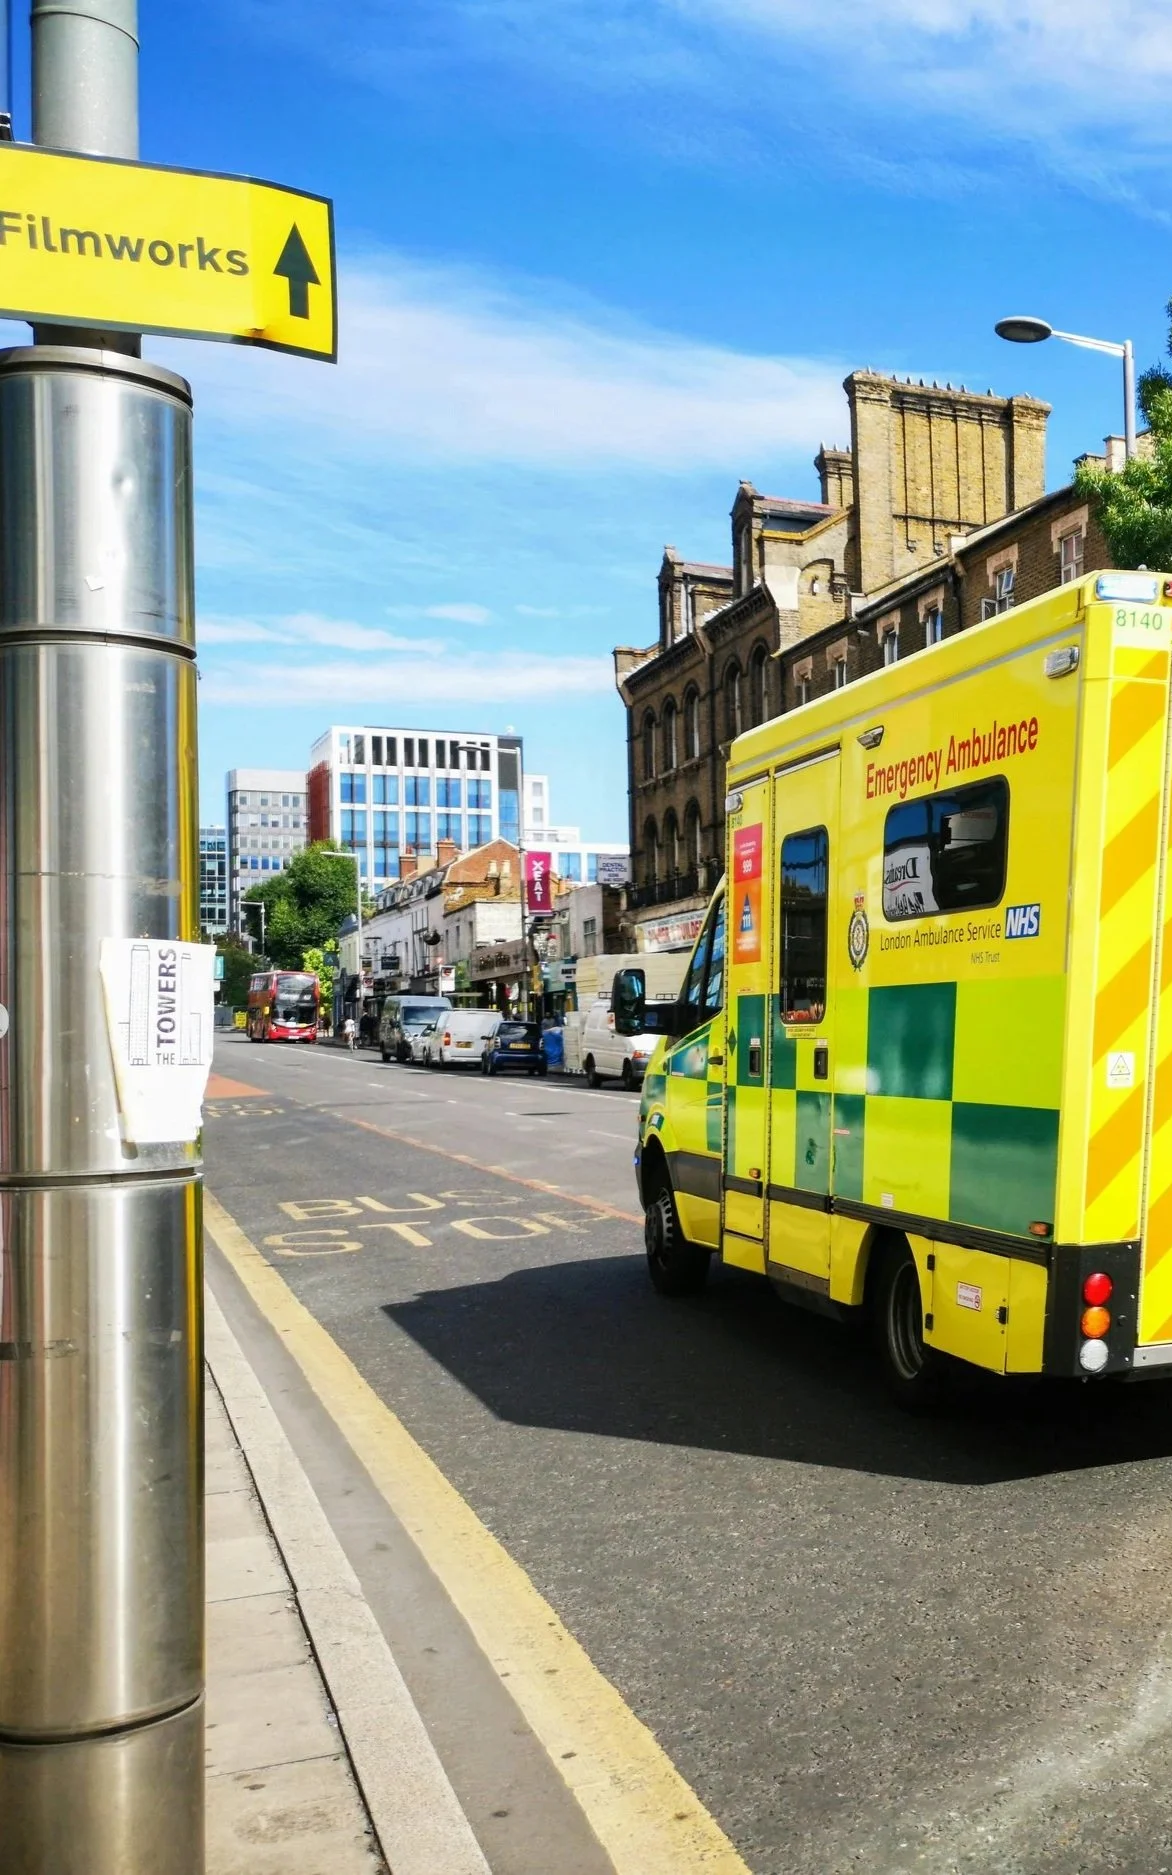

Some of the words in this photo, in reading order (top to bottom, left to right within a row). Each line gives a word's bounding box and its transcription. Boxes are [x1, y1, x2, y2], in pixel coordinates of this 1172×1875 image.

[0, 211, 250, 277] Filmworks
[1116, 609, 1163, 631] 8140
[866, 749, 943, 799] Emergency
[946, 716, 1039, 775] Ambulance
[880, 932, 911, 951] London
[913, 924, 964, 947] Ambulance
[967, 922, 1001, 943] Service
[1006, 905, 1039, 938] NHS
[157, 948, 177, 1048] TOWERS
[156, 1052, 175, 1065] THE
[277, 1188, 524, 1221] BUS
[262, 1209, 611, 1257] STOP
